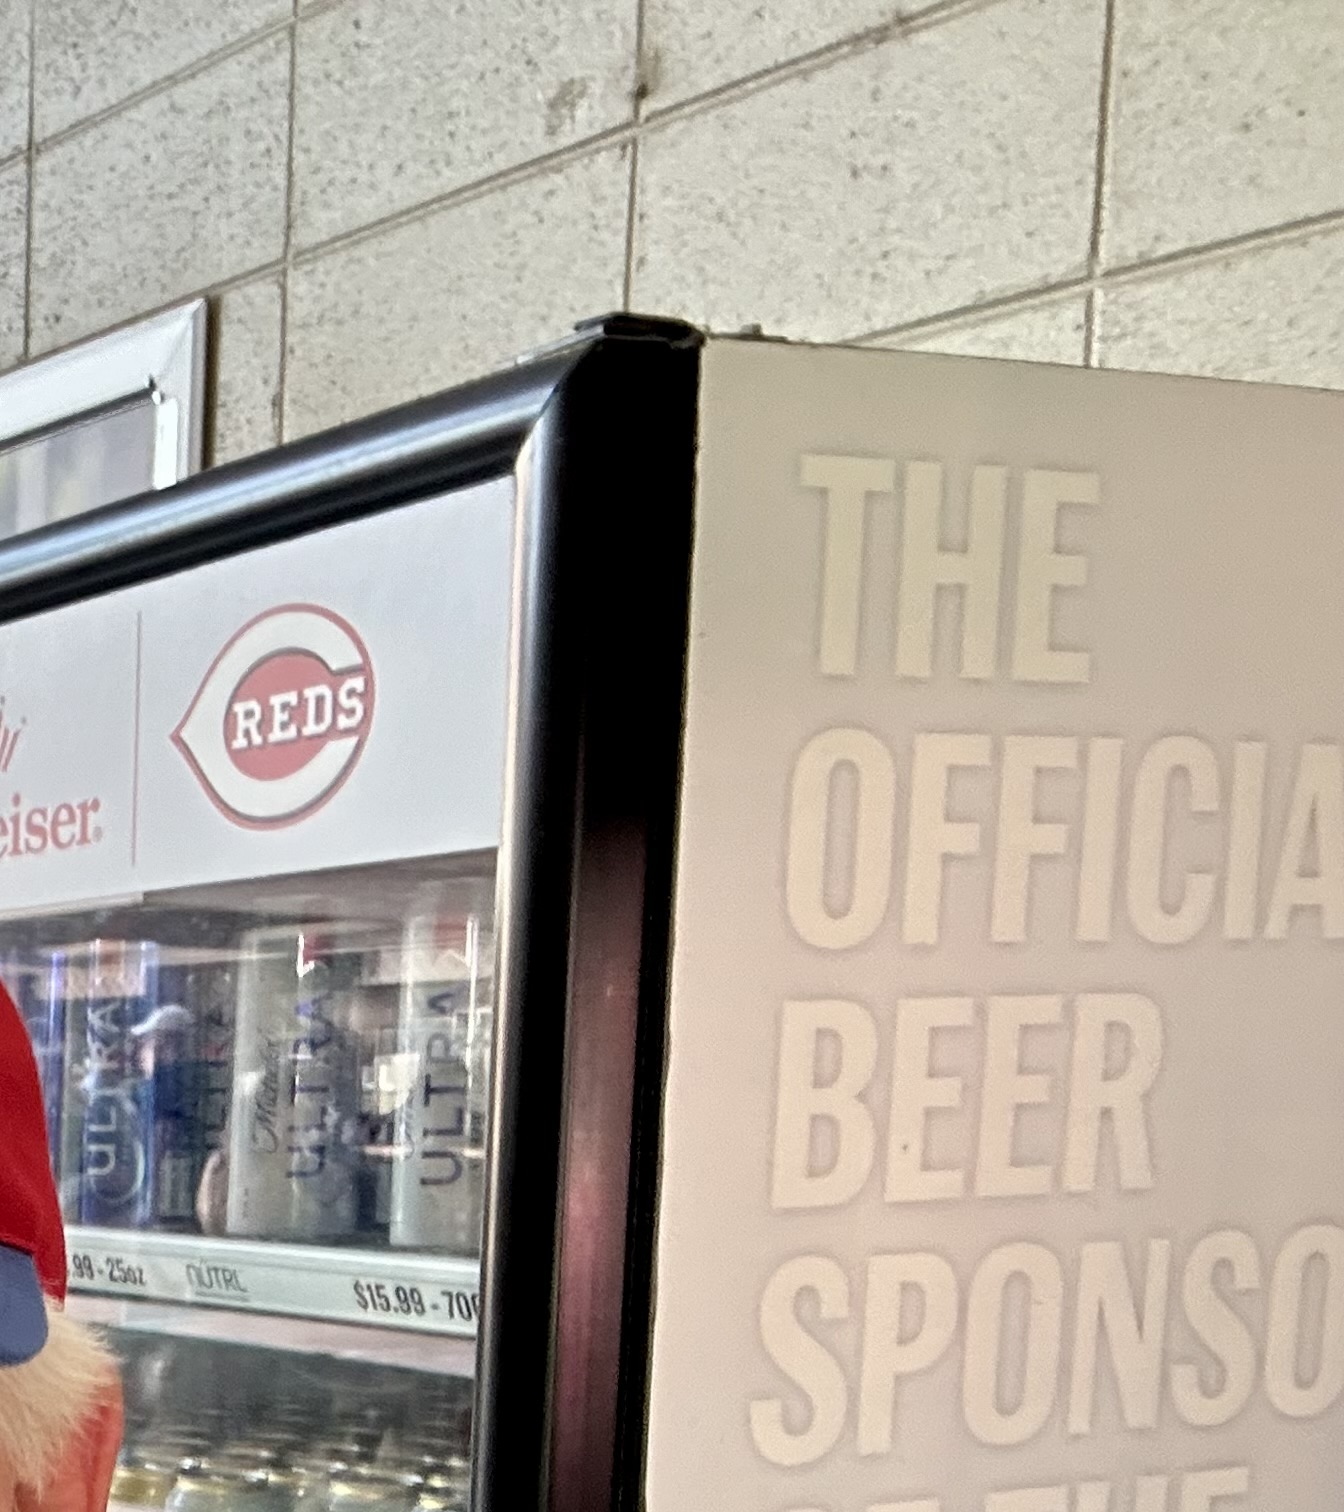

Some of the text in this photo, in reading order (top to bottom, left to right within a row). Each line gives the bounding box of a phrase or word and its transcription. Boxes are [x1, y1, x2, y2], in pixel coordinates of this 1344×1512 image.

[797, 453, 1101, 684] THE
[231, 676, 367, 750] REDS
[420, 984, 469, 1187] ULTRA
[771, 991, 1166, 1209] BEER
[353, 1279, 426, 1317] $15.99
